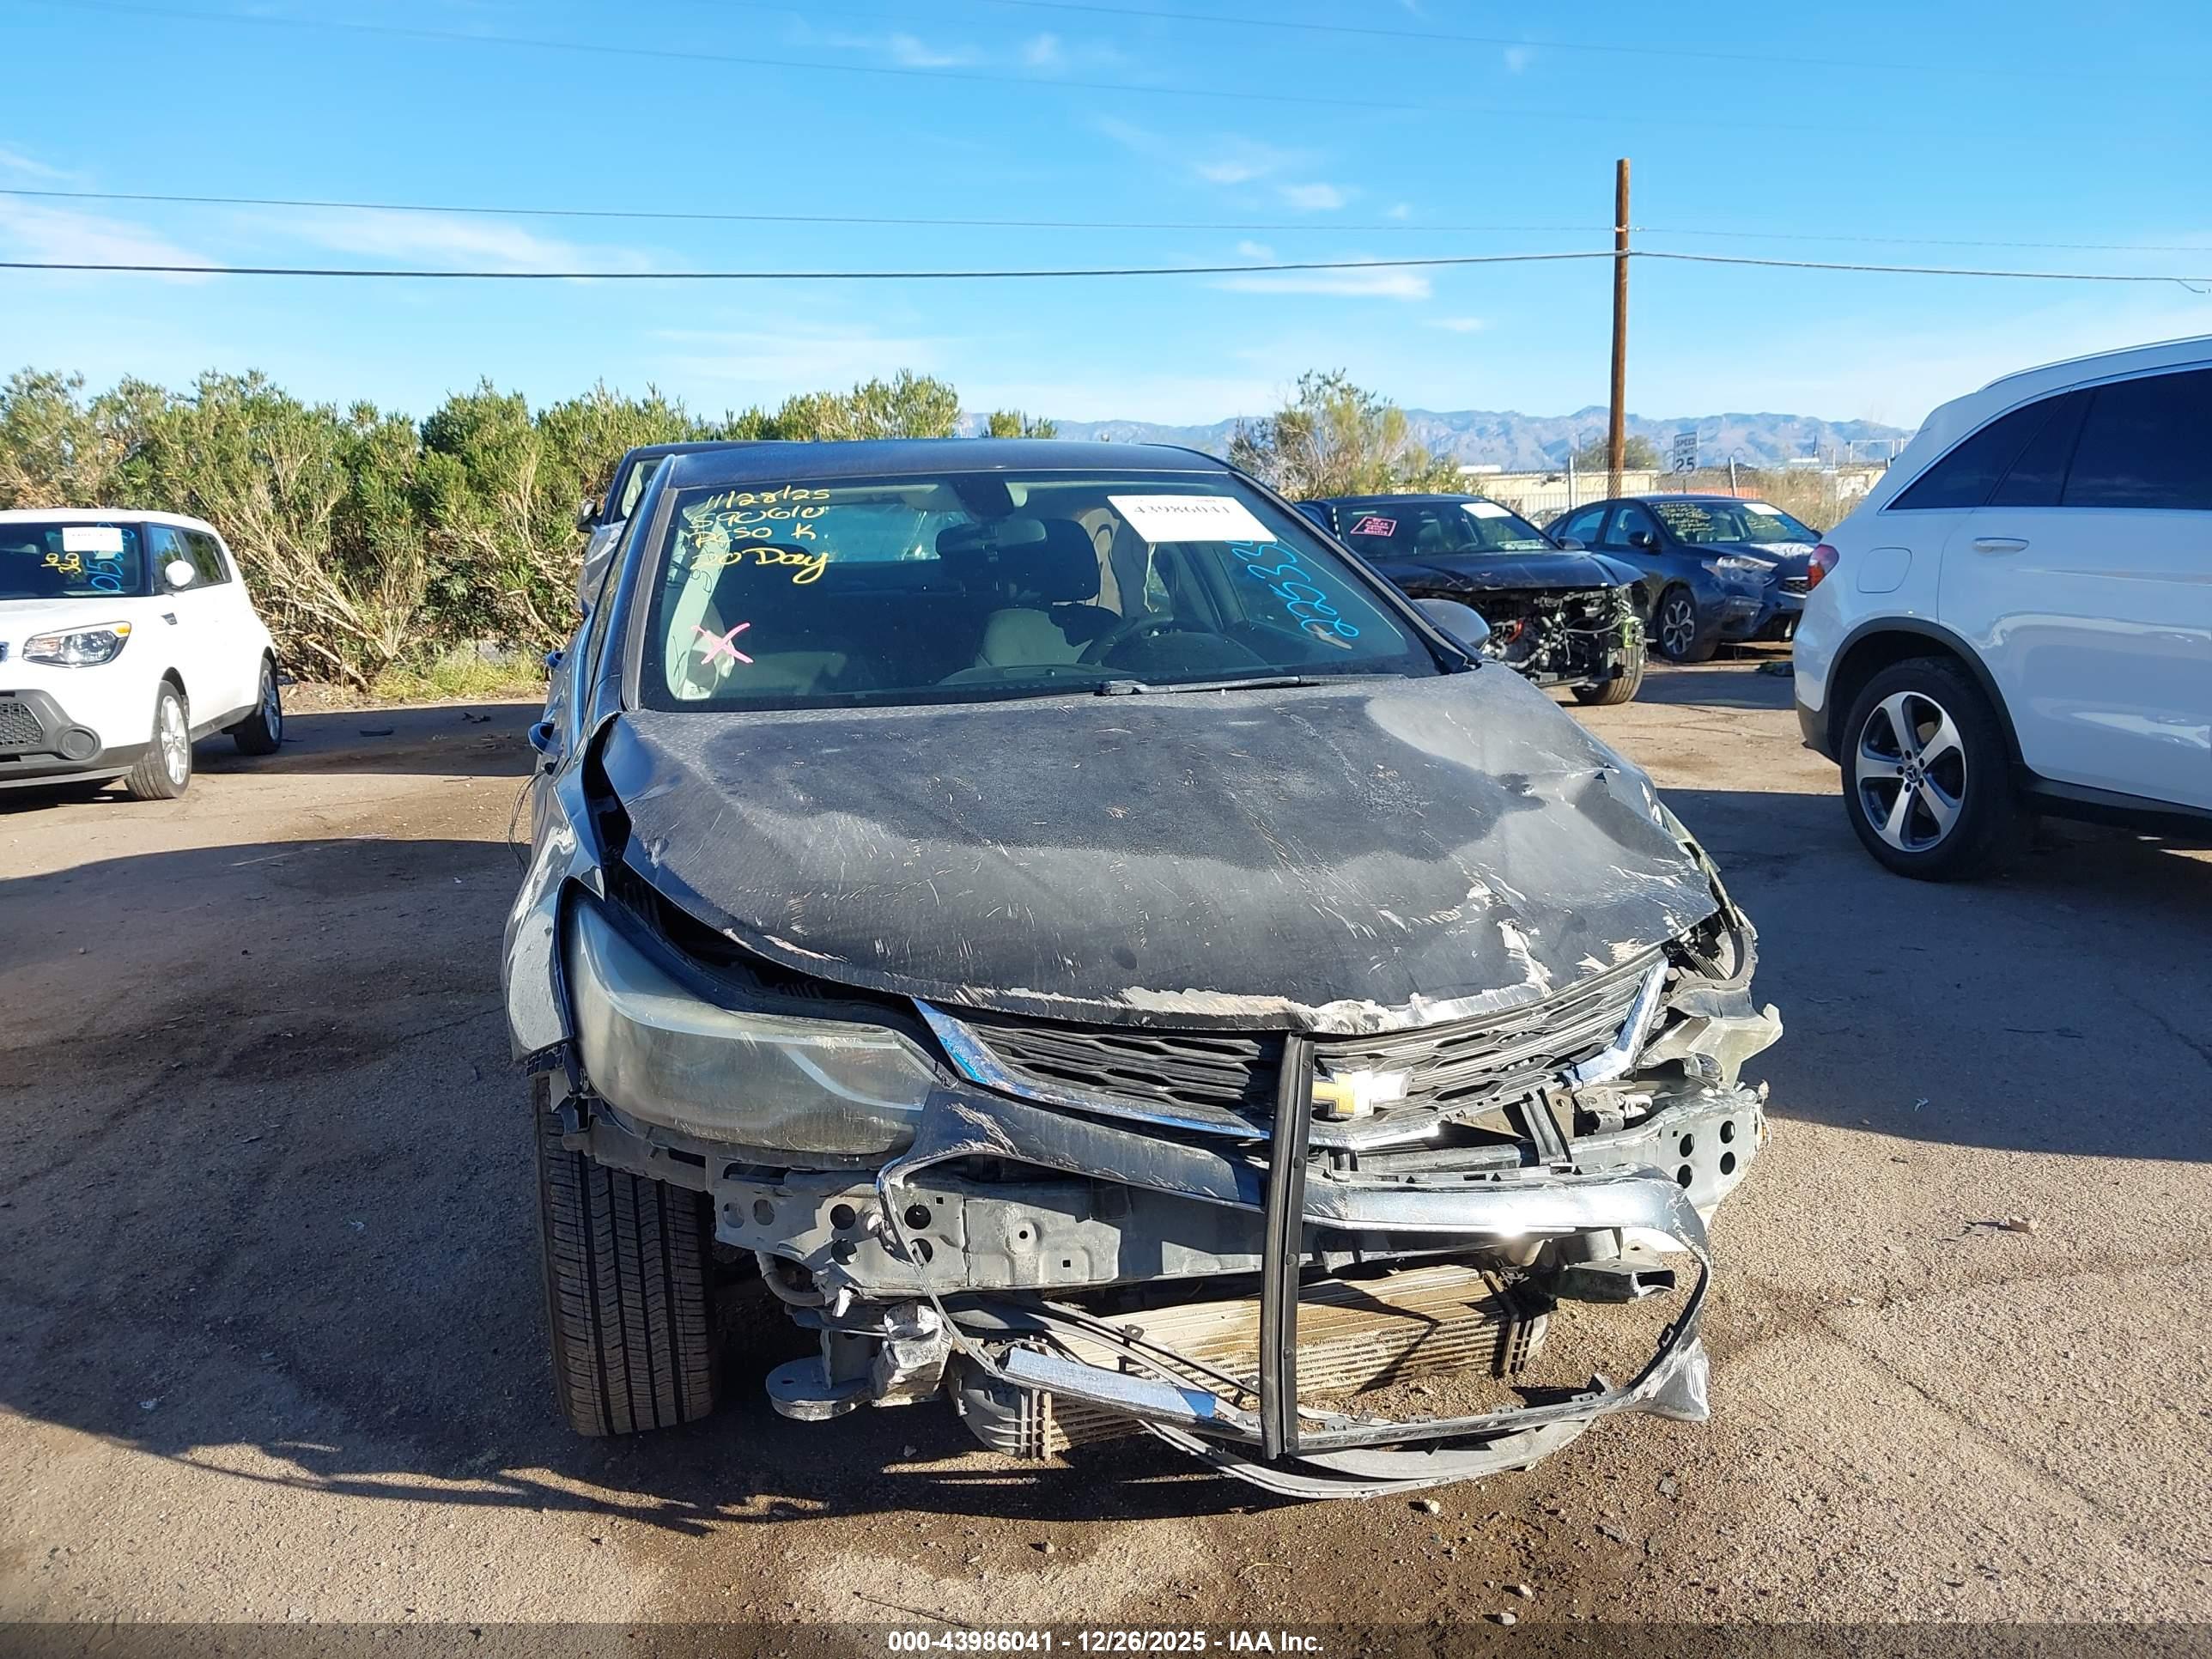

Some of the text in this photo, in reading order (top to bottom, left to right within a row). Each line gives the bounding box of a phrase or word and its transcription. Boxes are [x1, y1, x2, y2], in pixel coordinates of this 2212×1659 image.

[1676, 438, 1695, 447] SPEED
[1675, 457, 1695, 474] 25
[705, 484, 831, 510] 11/28/25
[741, 547, 830, 585] Day
